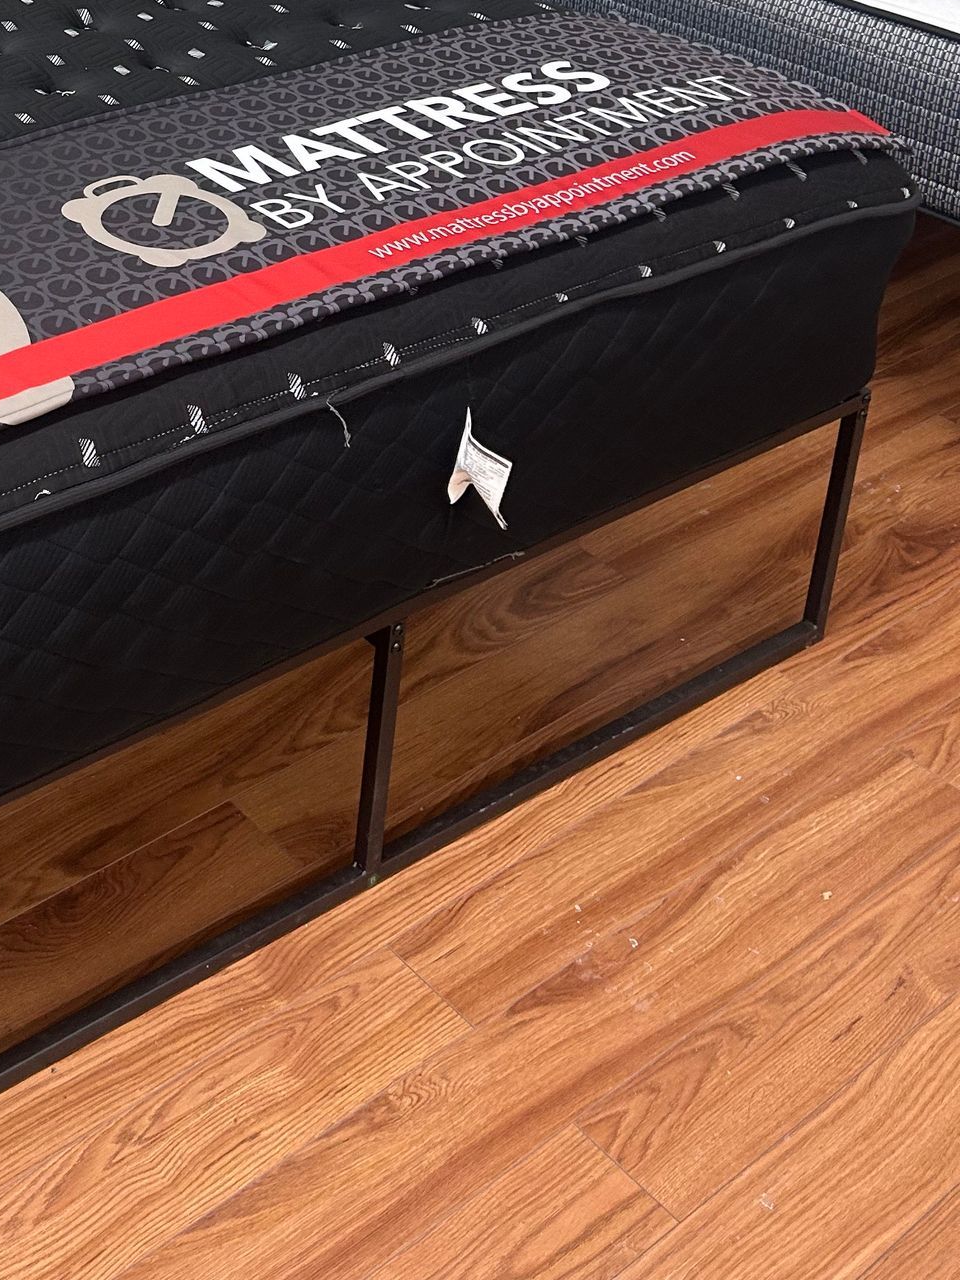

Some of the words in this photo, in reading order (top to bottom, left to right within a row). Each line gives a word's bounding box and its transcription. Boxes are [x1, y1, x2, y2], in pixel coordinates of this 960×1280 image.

[185, 60, 611, 193] MATTRESS
[249, 183, 346, 230] BY
[355, 75, 754, 202] APPOINTMENT
[368, 148, 696, 260] www.mattressbyappointment.com
